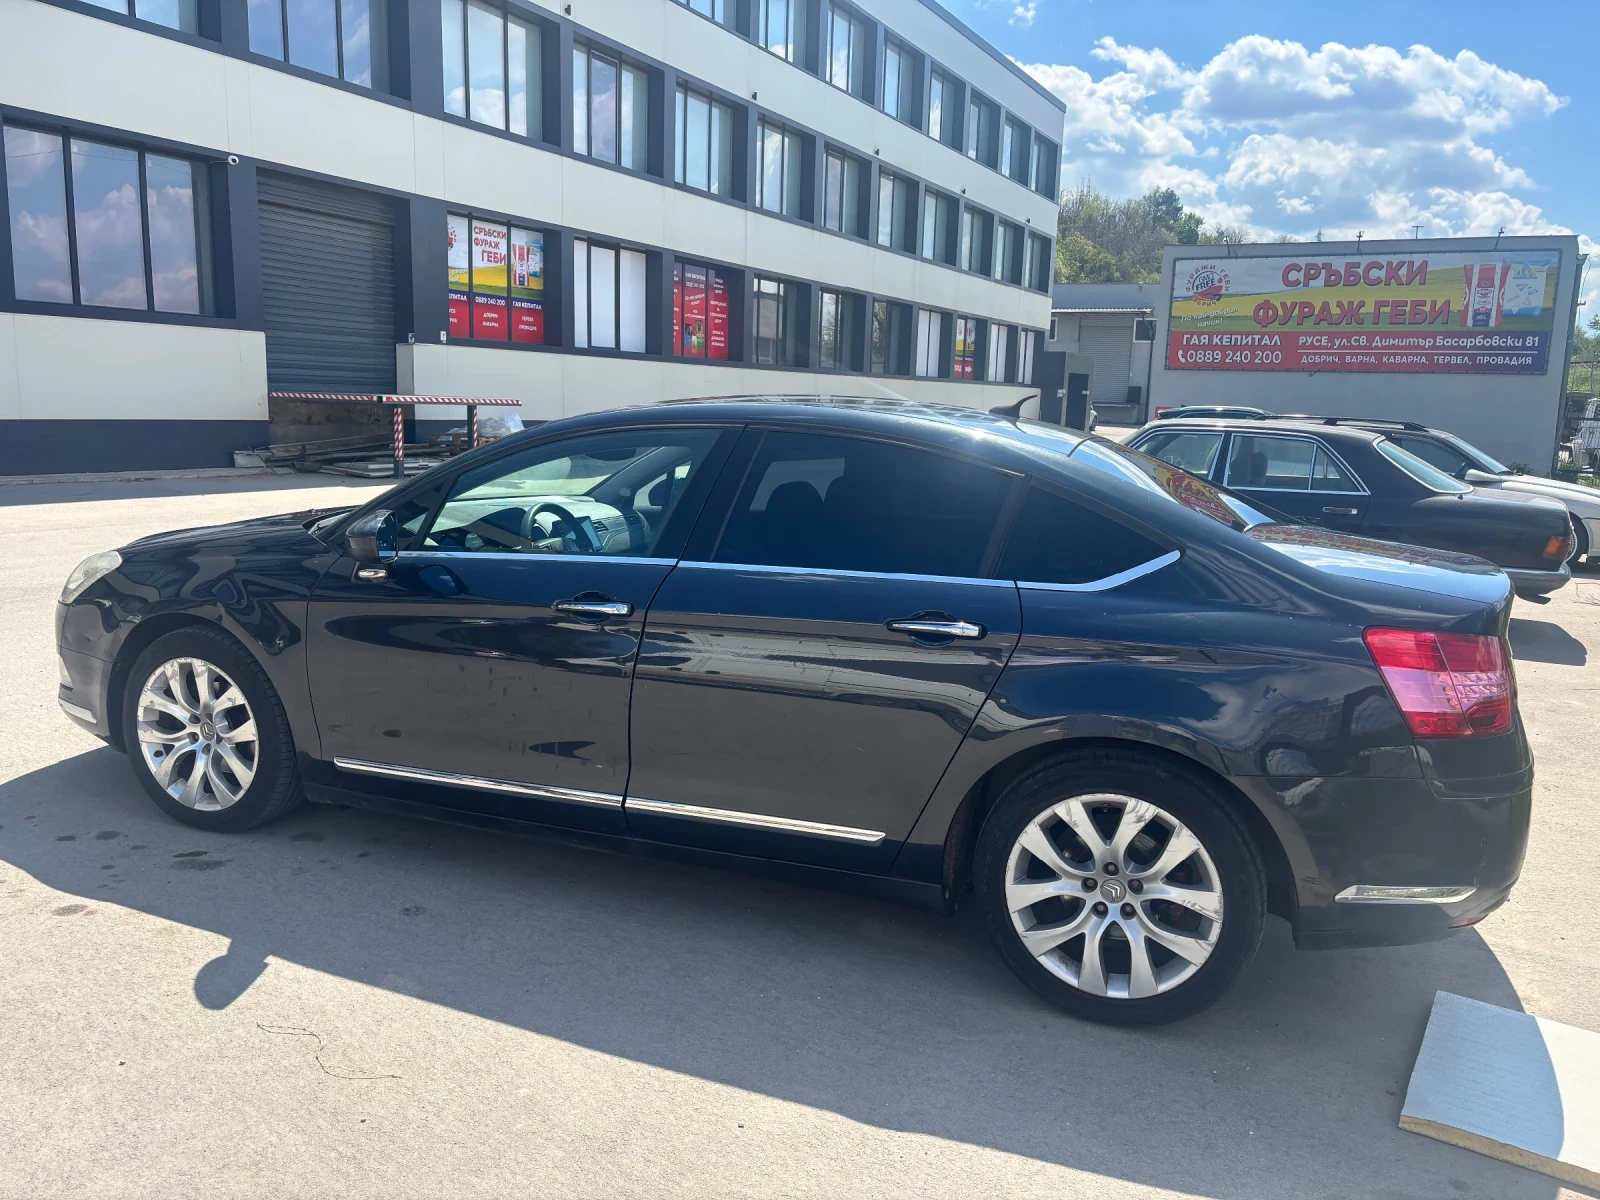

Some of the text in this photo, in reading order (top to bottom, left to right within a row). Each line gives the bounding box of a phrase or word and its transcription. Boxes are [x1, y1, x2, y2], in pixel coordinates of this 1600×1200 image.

[473, 226, 507, 240] СРЪБСКИ
[473, 237, 500, 250] ФУРАЖ
[481, 249, 507, 265] ГЕБИ
[1185, 264, 1231, 292] ФУРАЖИ ГЕБИ
[1281, 259, 1429, 288] СРЪБСКИ
[1195, 278, 1216, 291] FREE
[1252, 299, 1366, 328] ФУРАЖ
[1372, 299, 1451, 325] ГЕБИ
[1182, 334, 1282, 346] ГАЯ КЕПИТАЛ
[1298, 334, 1539, 349] РУСЕ, ул.Св. Димитър Басарбовски 81
[1186, 350, 1282, 364] 0889 240 200
[1300, 355, 1532, 366] ДОБРИЧ, ВАРНА, КАВАРНА, ТЕРВЕЛ, ПРОВАДИЯ
